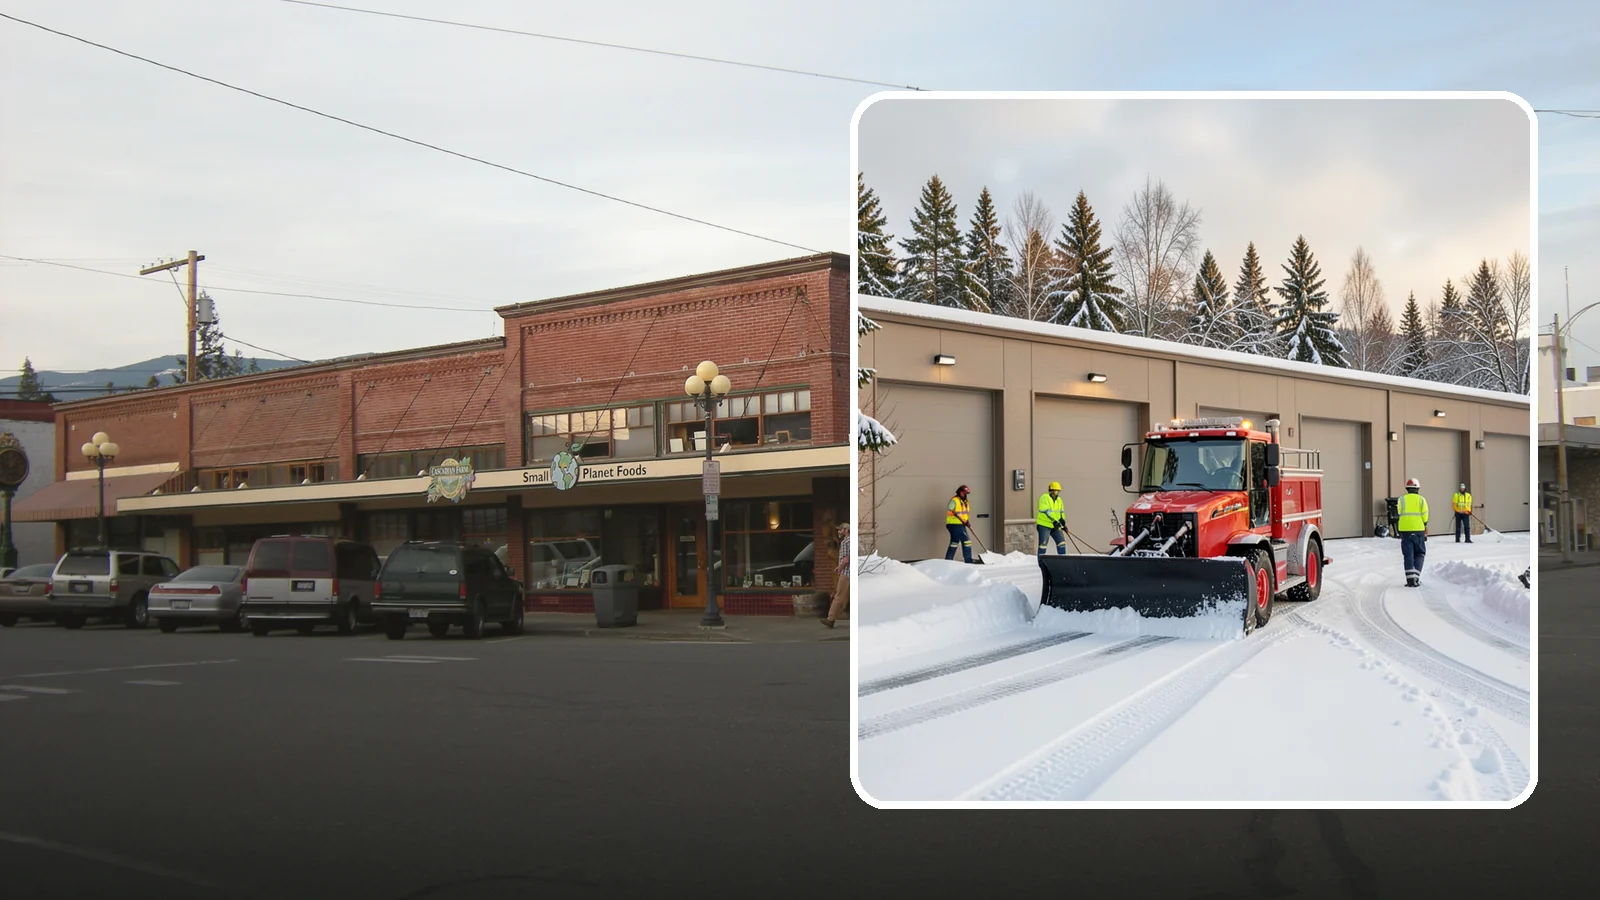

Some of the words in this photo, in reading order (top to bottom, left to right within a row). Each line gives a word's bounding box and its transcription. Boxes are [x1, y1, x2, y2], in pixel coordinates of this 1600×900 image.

[523, 471, 549, 483] Small
[582, 468, 614, 479] Planet
[617, 464, 647, 477] Foods
